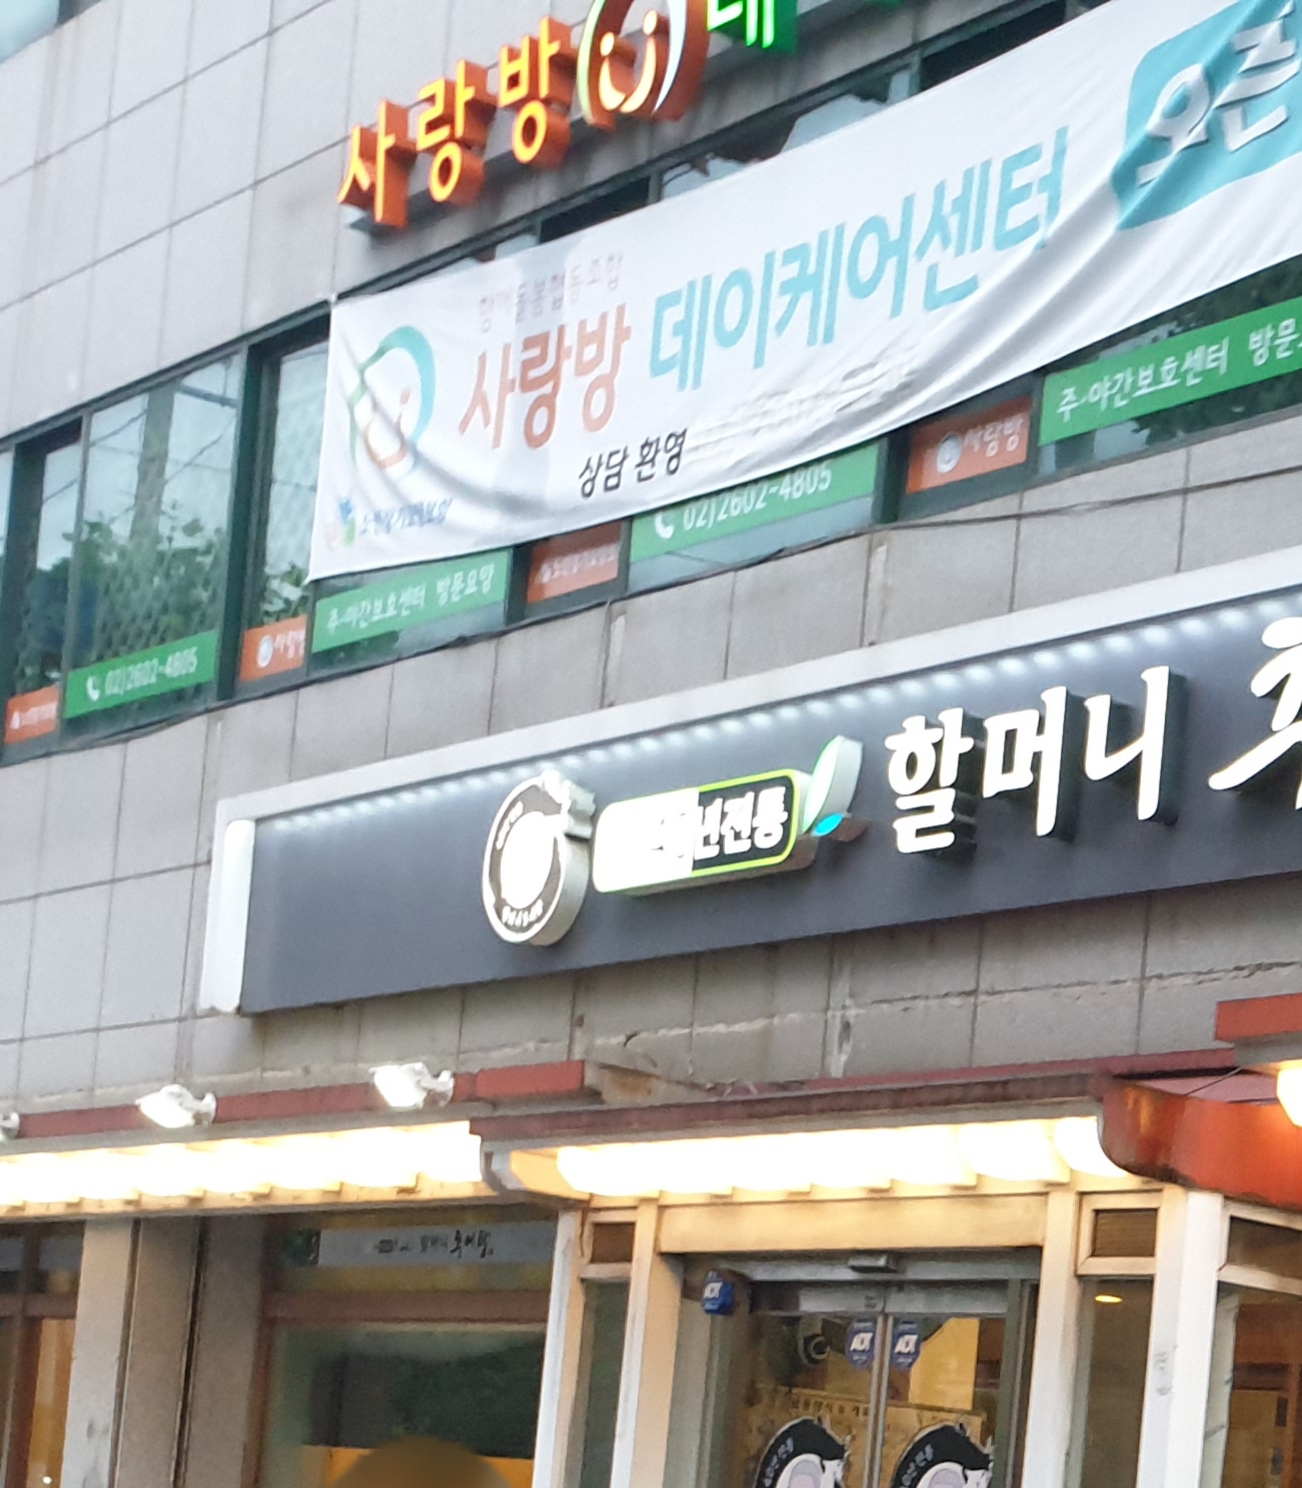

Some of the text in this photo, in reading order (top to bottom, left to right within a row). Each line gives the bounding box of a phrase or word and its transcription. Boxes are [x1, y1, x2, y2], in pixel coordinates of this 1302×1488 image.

[337, 15, 562, 223] 사랑방
[458, 126, 1070, 450] 사랑방 데이케어센터
[578, 428, 688, 498] 상담 환영
[962, 418, 1026, 458] 사랑방
[104, 648, 199, 696] 02)2602-4805
[885, 664, 1172, 854] 할머니
